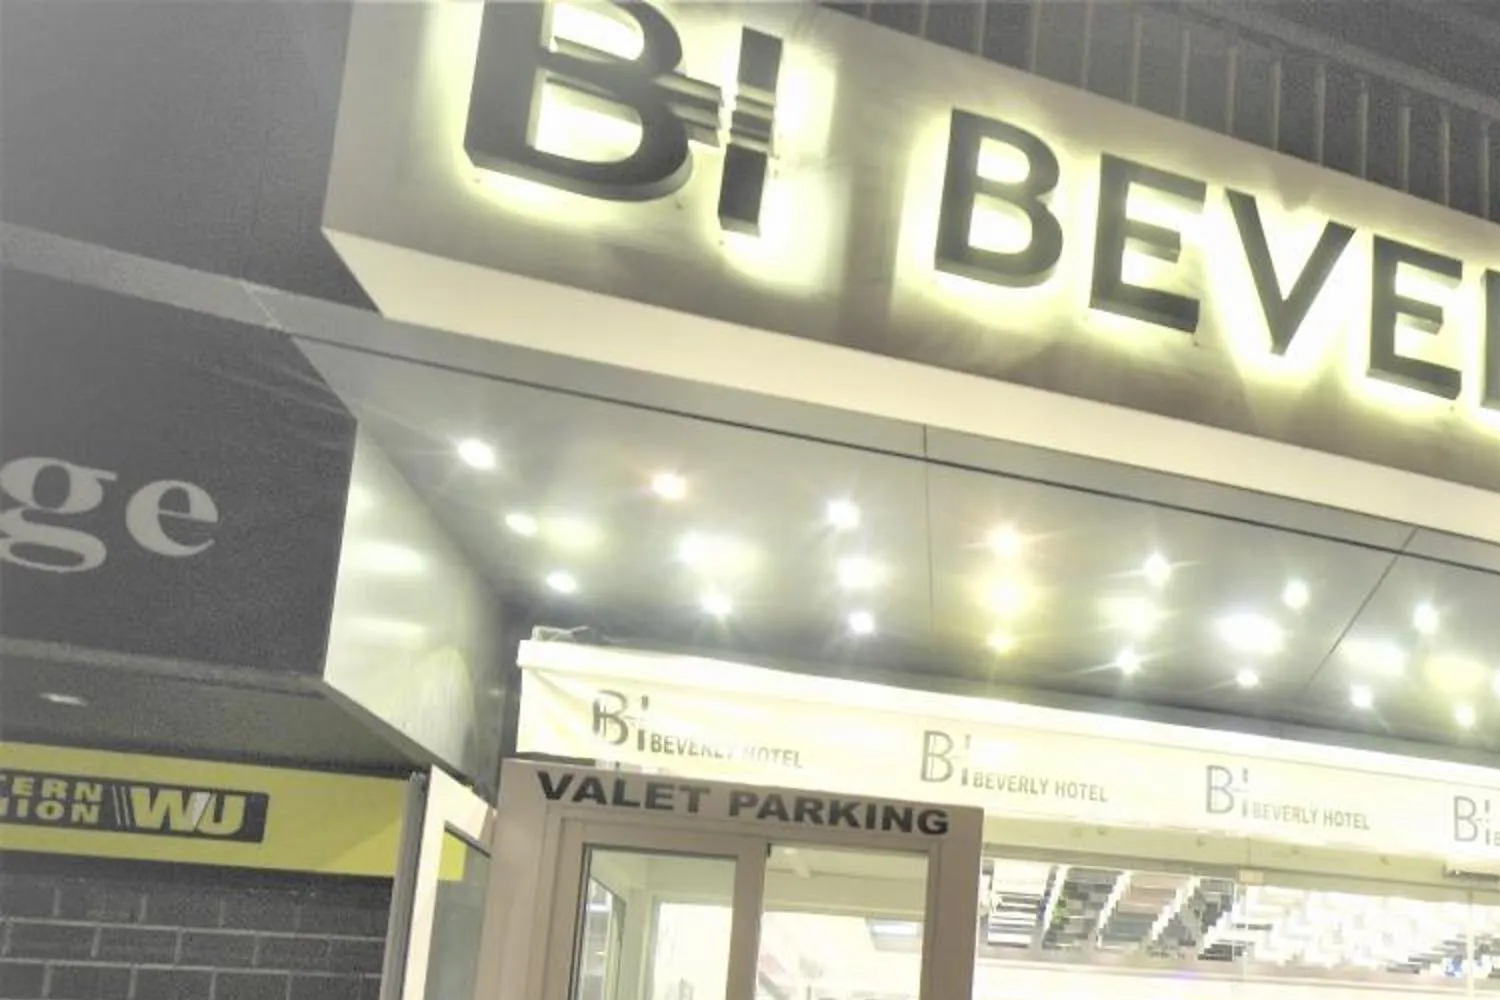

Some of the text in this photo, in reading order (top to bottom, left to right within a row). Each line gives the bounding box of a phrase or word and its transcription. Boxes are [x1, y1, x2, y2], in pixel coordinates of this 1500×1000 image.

[650, 733, 732, 759] BEVERL
[973, 771, 1049, 795] BEVERLY
[1055, 780, 1109, 802] HOTEL
[537, 770, 950, 836] VALET PARKING
[1252, 801, 1319, 825] BEVERLY
[1323, 809, 1371, 831] HOTEL
